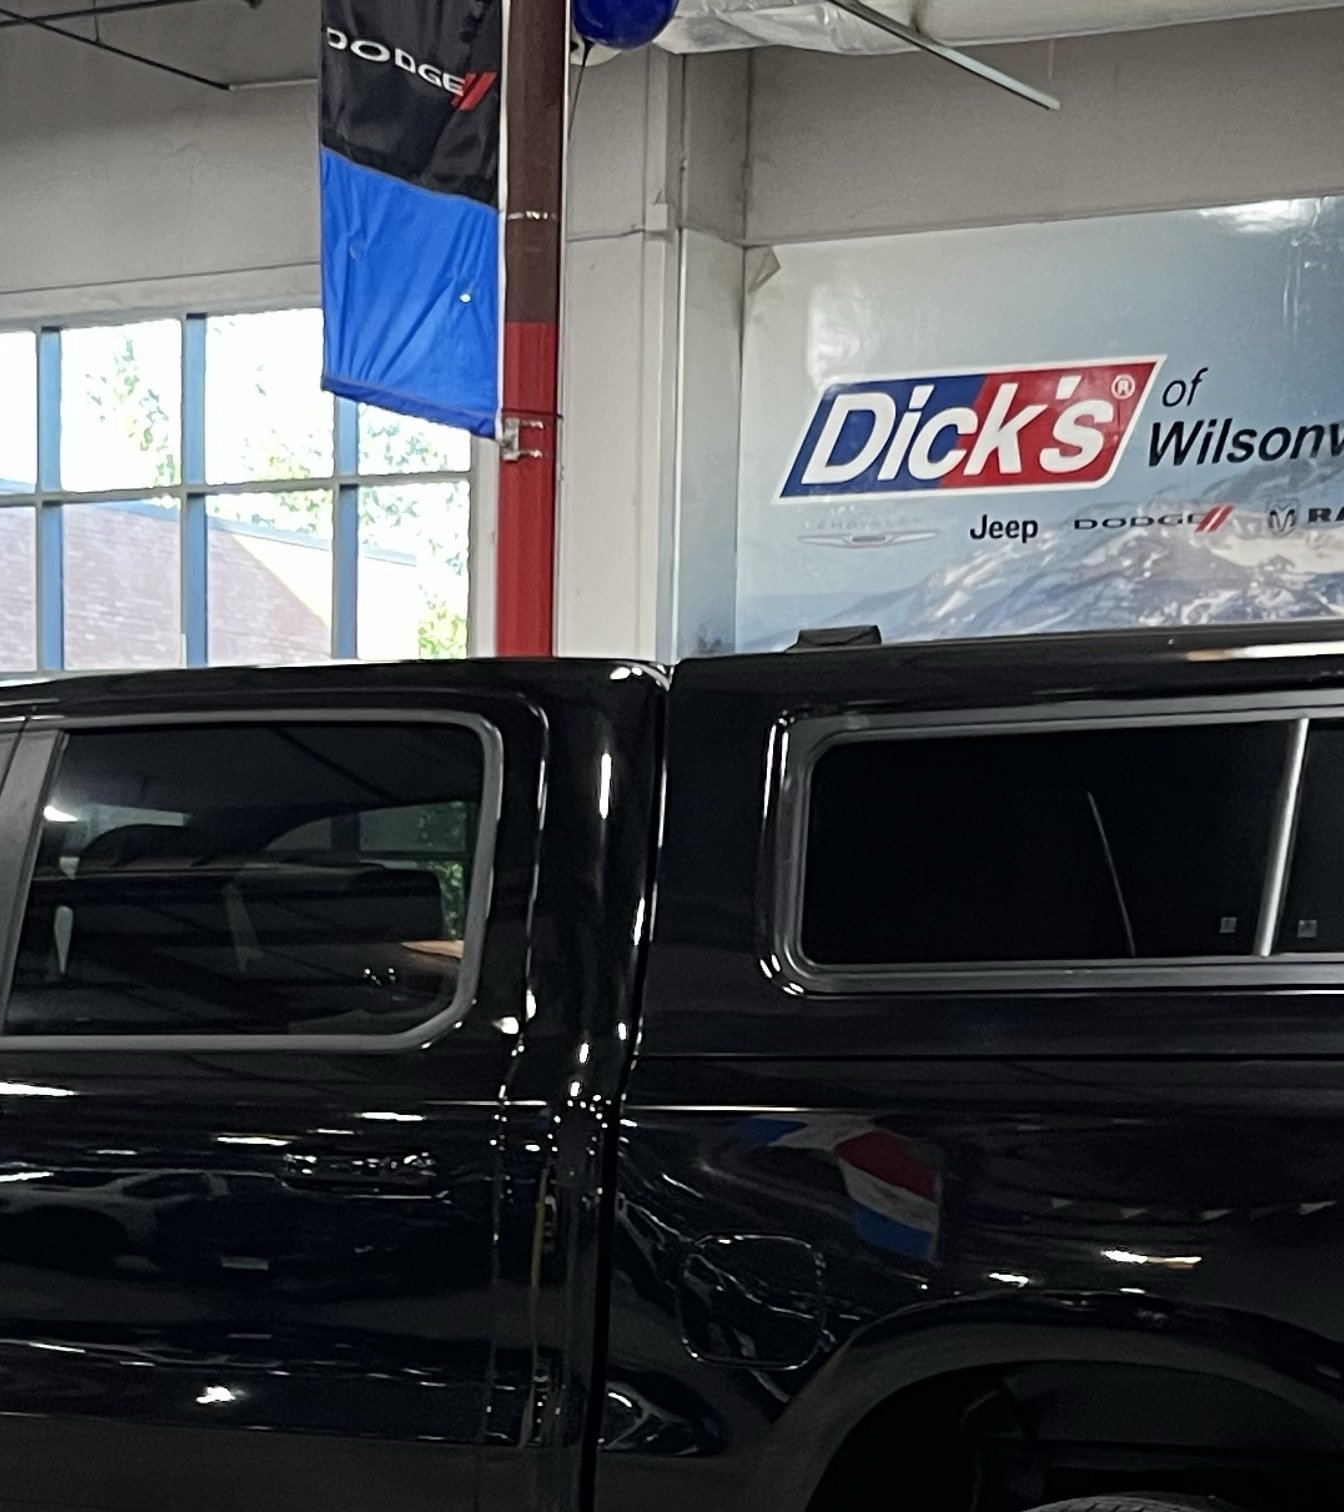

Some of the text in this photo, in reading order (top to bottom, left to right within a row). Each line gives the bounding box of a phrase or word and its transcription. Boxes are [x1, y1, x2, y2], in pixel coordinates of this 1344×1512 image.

[327, 27, 466, 96] DODGE
[1162, 367, 1209, 408] of
[801, 375, 1114, 485] Dick's
[969, 514, 1039, 543] Jeep
[1074, 512, 1207, 530] DODGE
